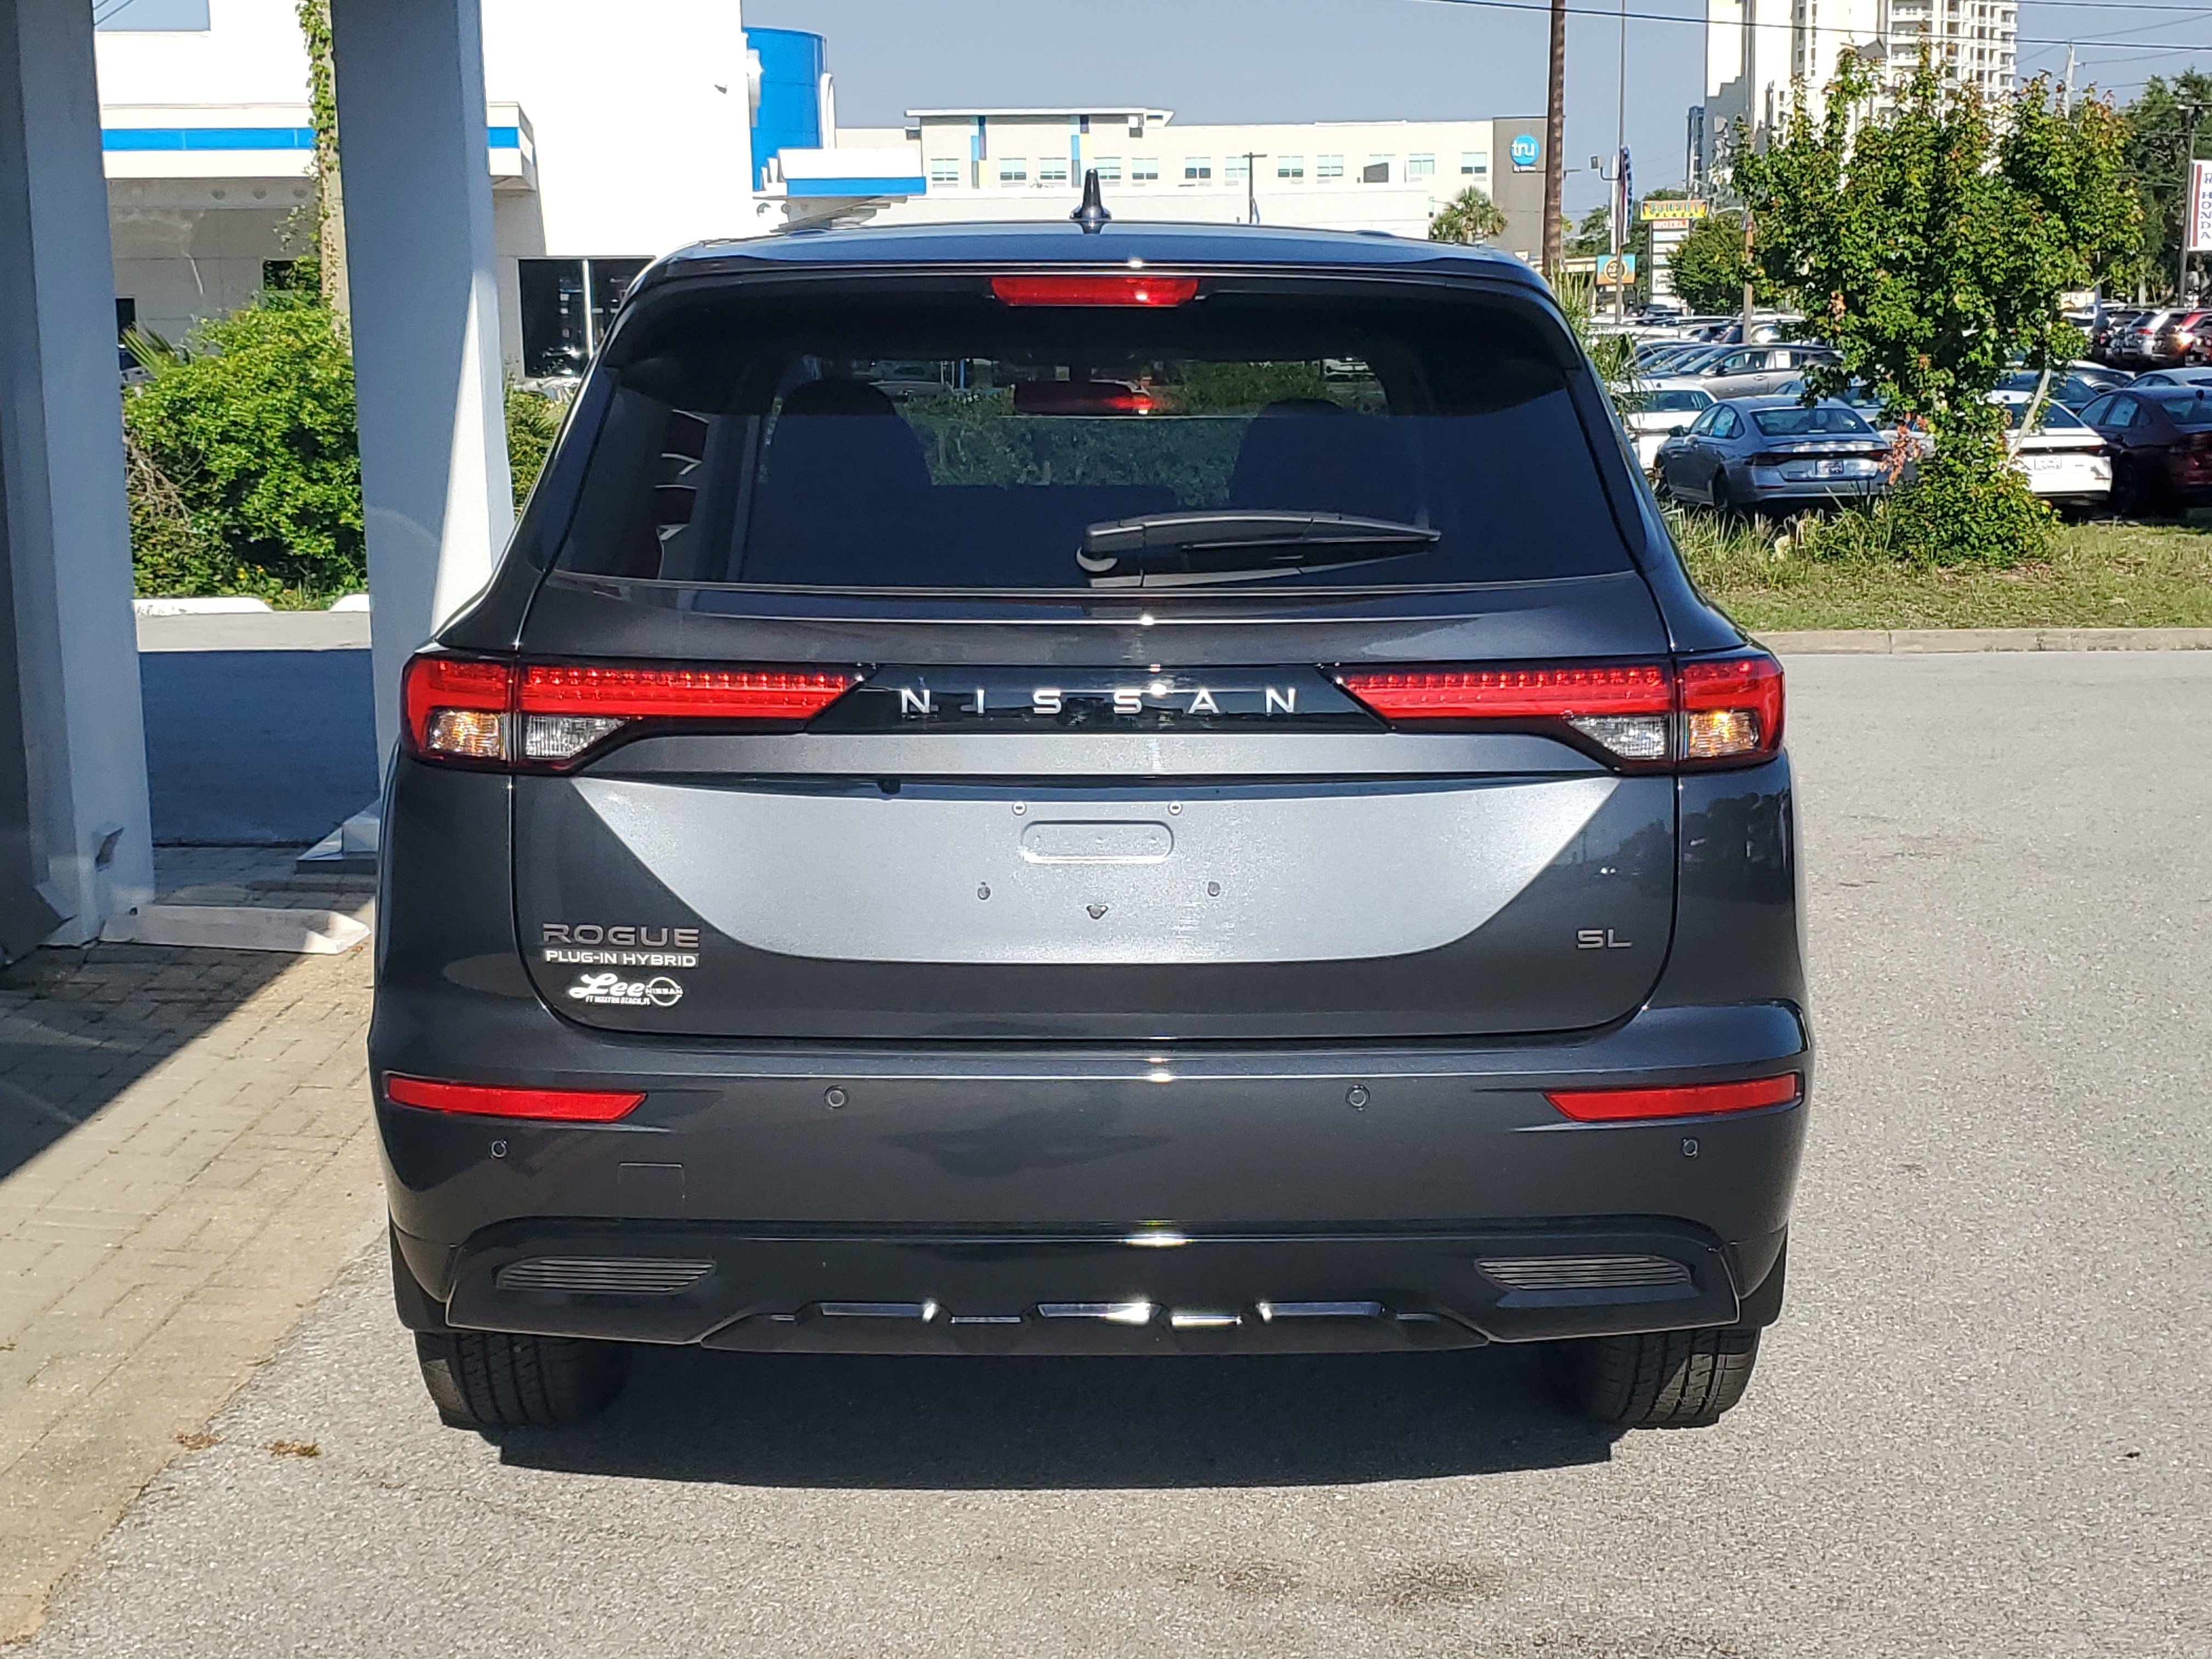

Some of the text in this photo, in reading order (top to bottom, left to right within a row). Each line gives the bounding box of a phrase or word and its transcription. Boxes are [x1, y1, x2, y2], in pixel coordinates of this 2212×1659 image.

[1511, 139, 1535, 157] tru
[2200, 191, 2212, 239] HONDA
[900, 688, 1296, 714] NISSAN
[543, 923, 699, 949] ROGUE
[1577, 929, 1632, 949] SL
[545, 950, 696, 967] PLUG-IN HYBRID
[569, 973, 646, 998] Lee
